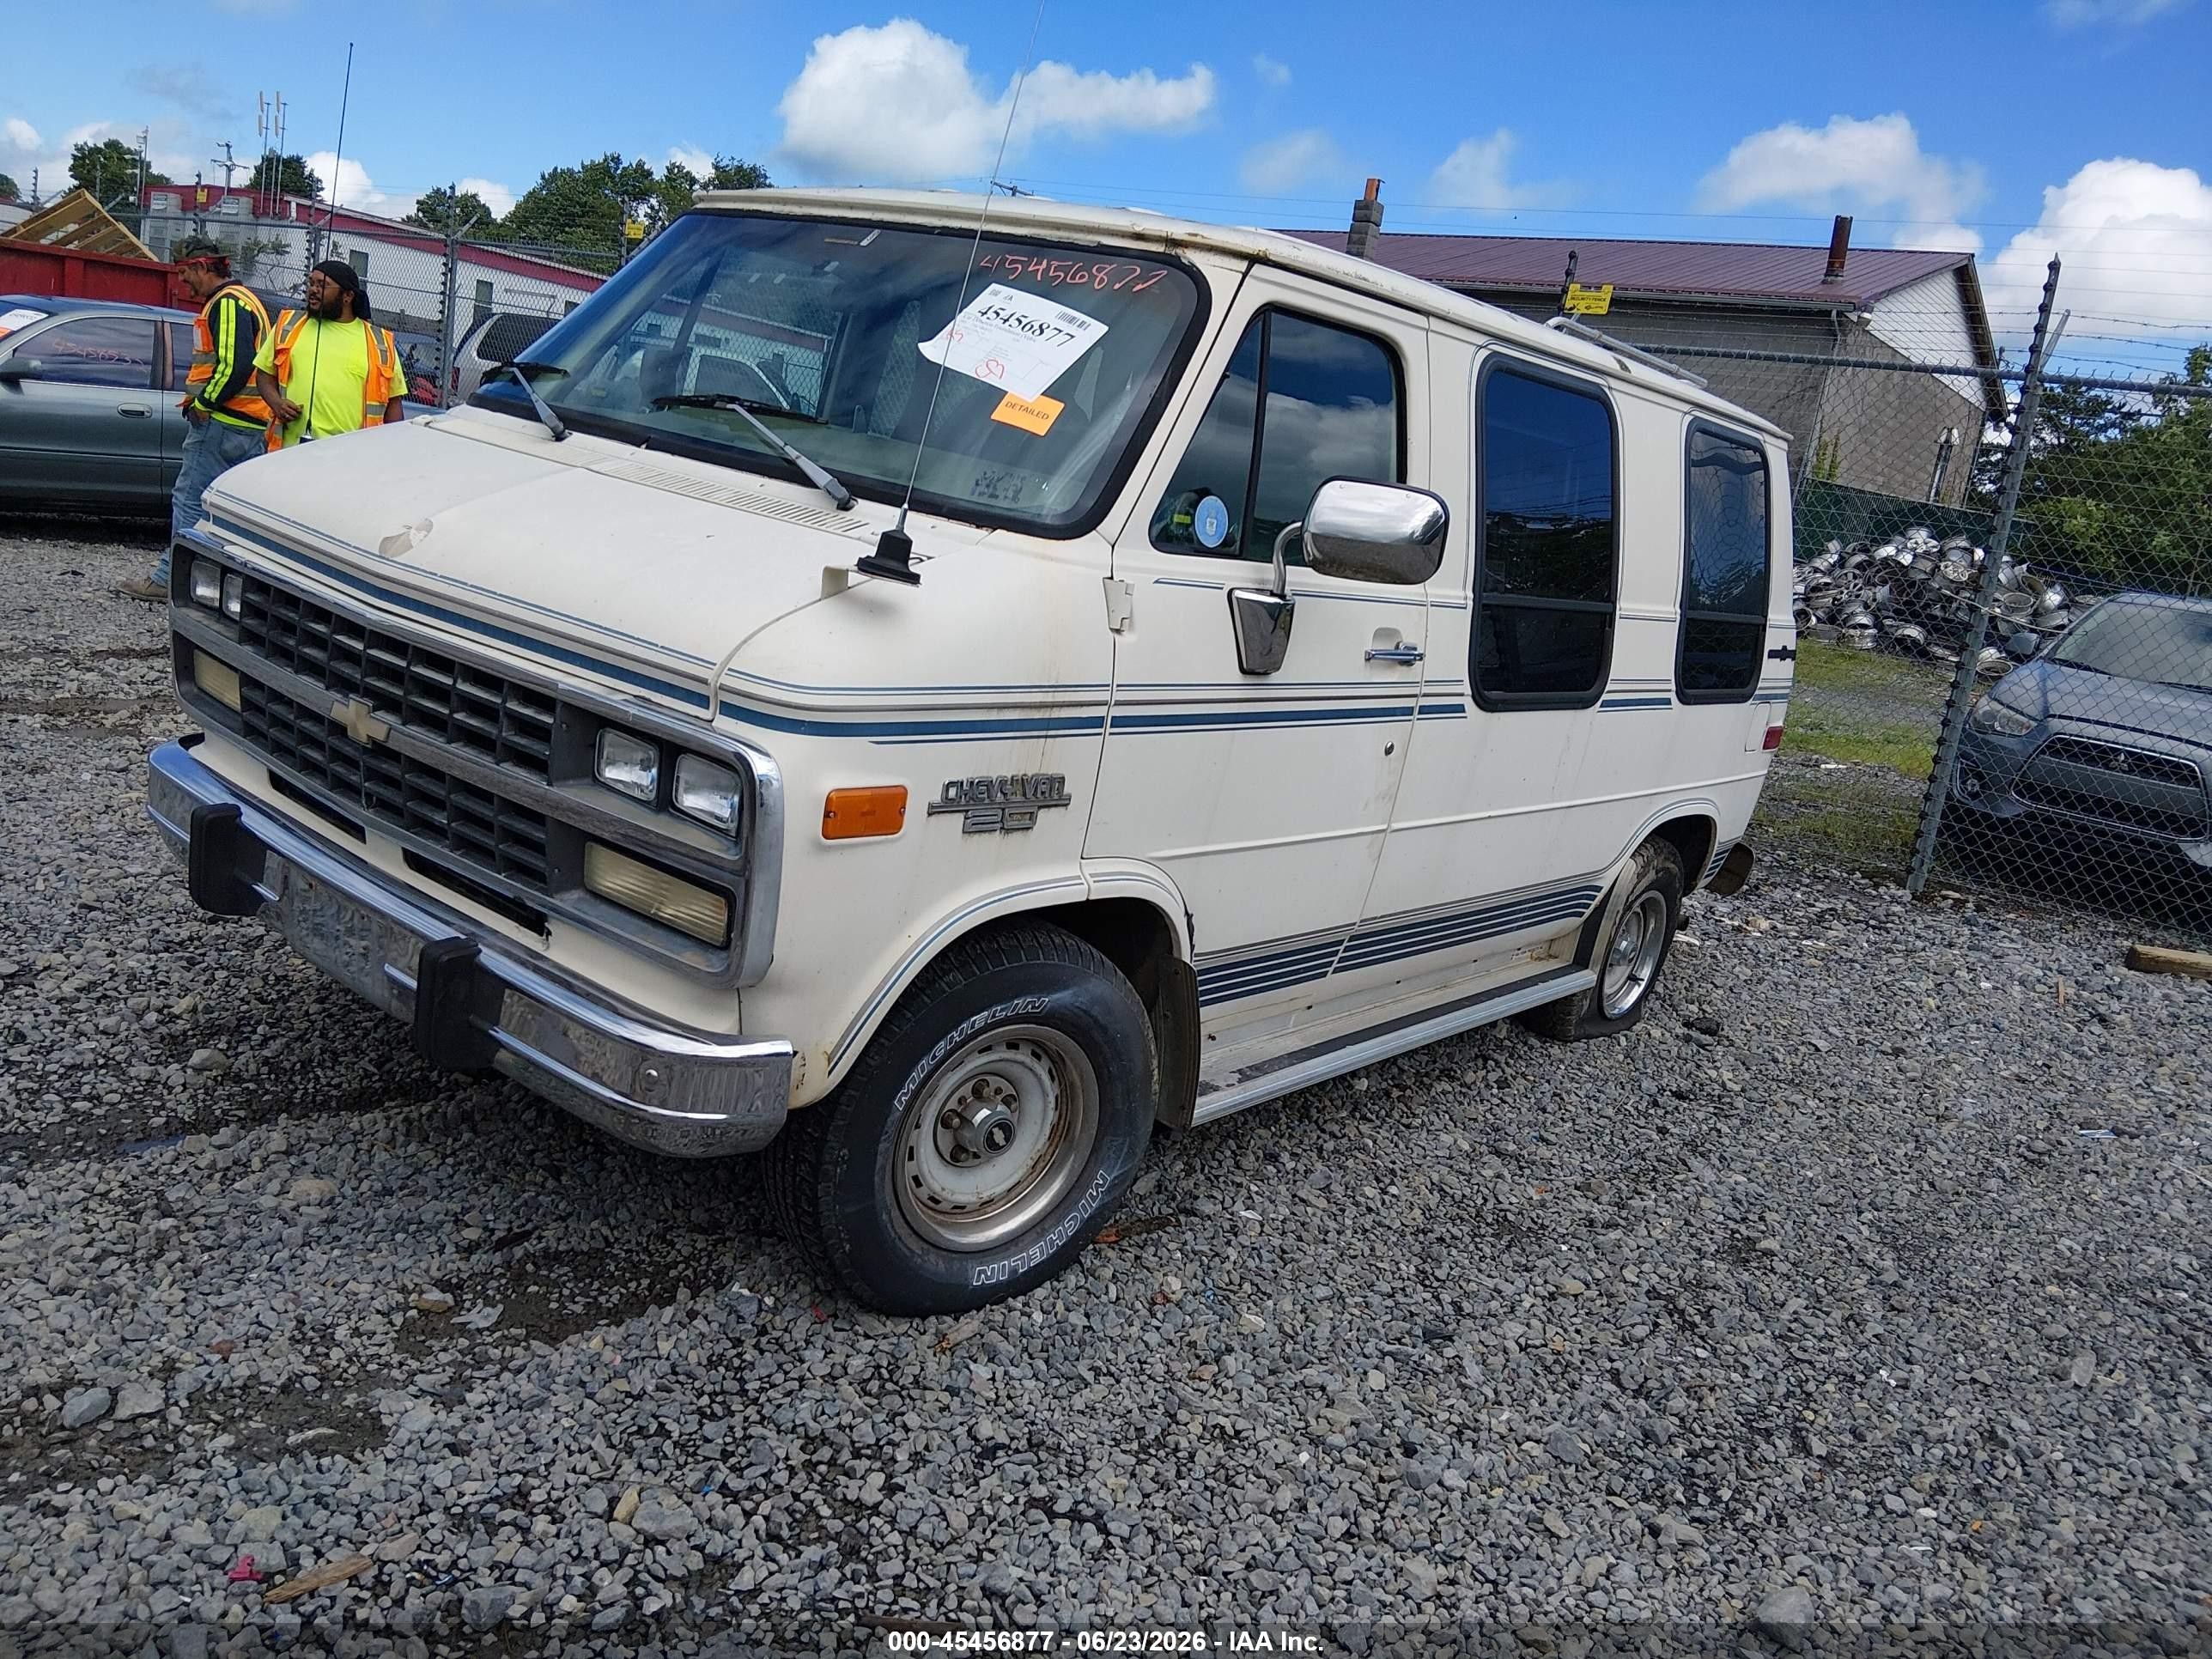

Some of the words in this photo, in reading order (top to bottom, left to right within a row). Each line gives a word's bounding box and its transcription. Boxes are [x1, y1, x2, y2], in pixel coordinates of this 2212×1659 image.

[978, 304, 1076, 347] 45456877
[1005, 401, 1050, 420] DETAILED
[963, 805, 1038, 833] 20
[894, 997, 1049, 1112] MICHELIN
[972, 1170, 1110, 1286] MICHELIN
